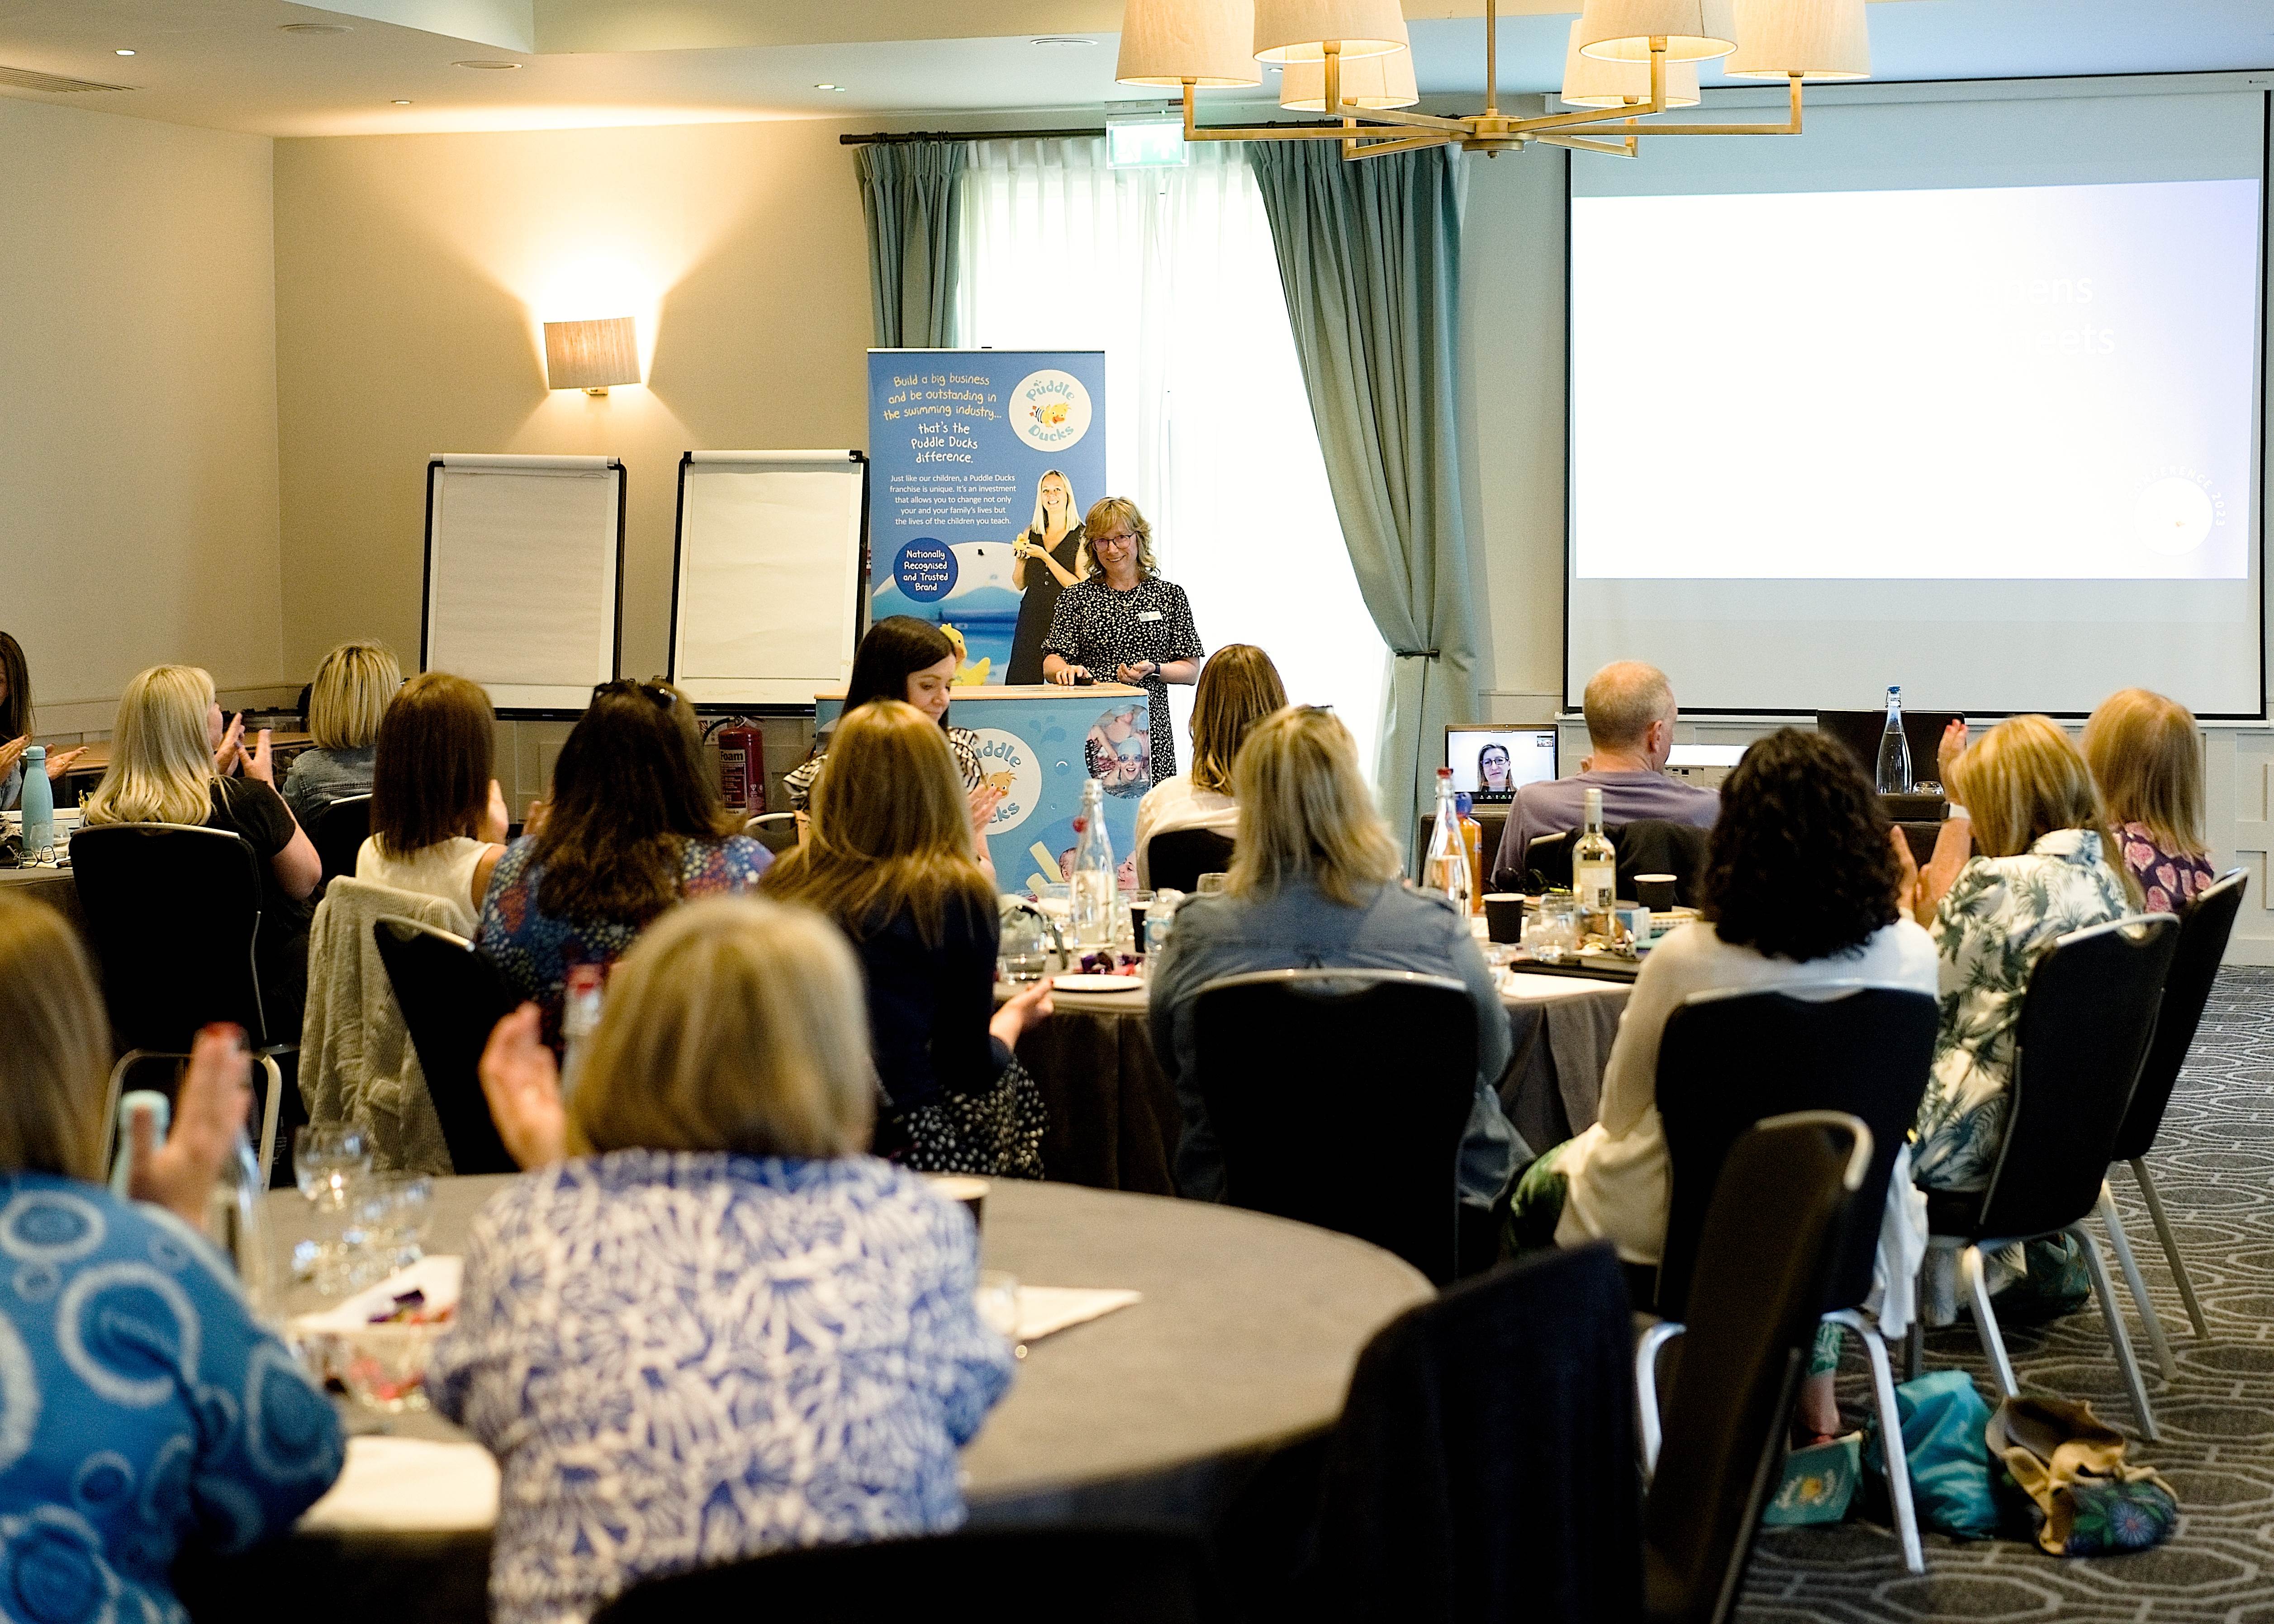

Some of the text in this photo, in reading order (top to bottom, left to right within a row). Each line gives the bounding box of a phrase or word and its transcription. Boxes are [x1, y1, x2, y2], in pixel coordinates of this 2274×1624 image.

[893, 374, 917, 387] Build
[931, 374, 945, 386] big
[950, 373, 989, 385] business
[888, 391, 906, 404] and
[911, 390, 921, 400] be
[926, 389, 983, 404] outstanding
[1026, 380, 1074, 401] Puddle
[883, 405, 1001, 421] the swimming industry...
[918, 421, 970, 434] that's the
[1028, 424, 1074, 441] Ducks
[911, 436, 978, 449] Puddle Ducks
[916, 451, 973, 463] difference.
[2212, 492, 2226, 526] 2023
[907, 550, 945, 560] Nationally
[904, 561, 947, 572] Recognised
[903, 573, 948, 581] and Trusted
[915, 582, 937, 591] Brand
[721, 751, 743, 761] Foam
[976, 740, 1021, 767] ddle
[989, 803, 1020, 823] cks
